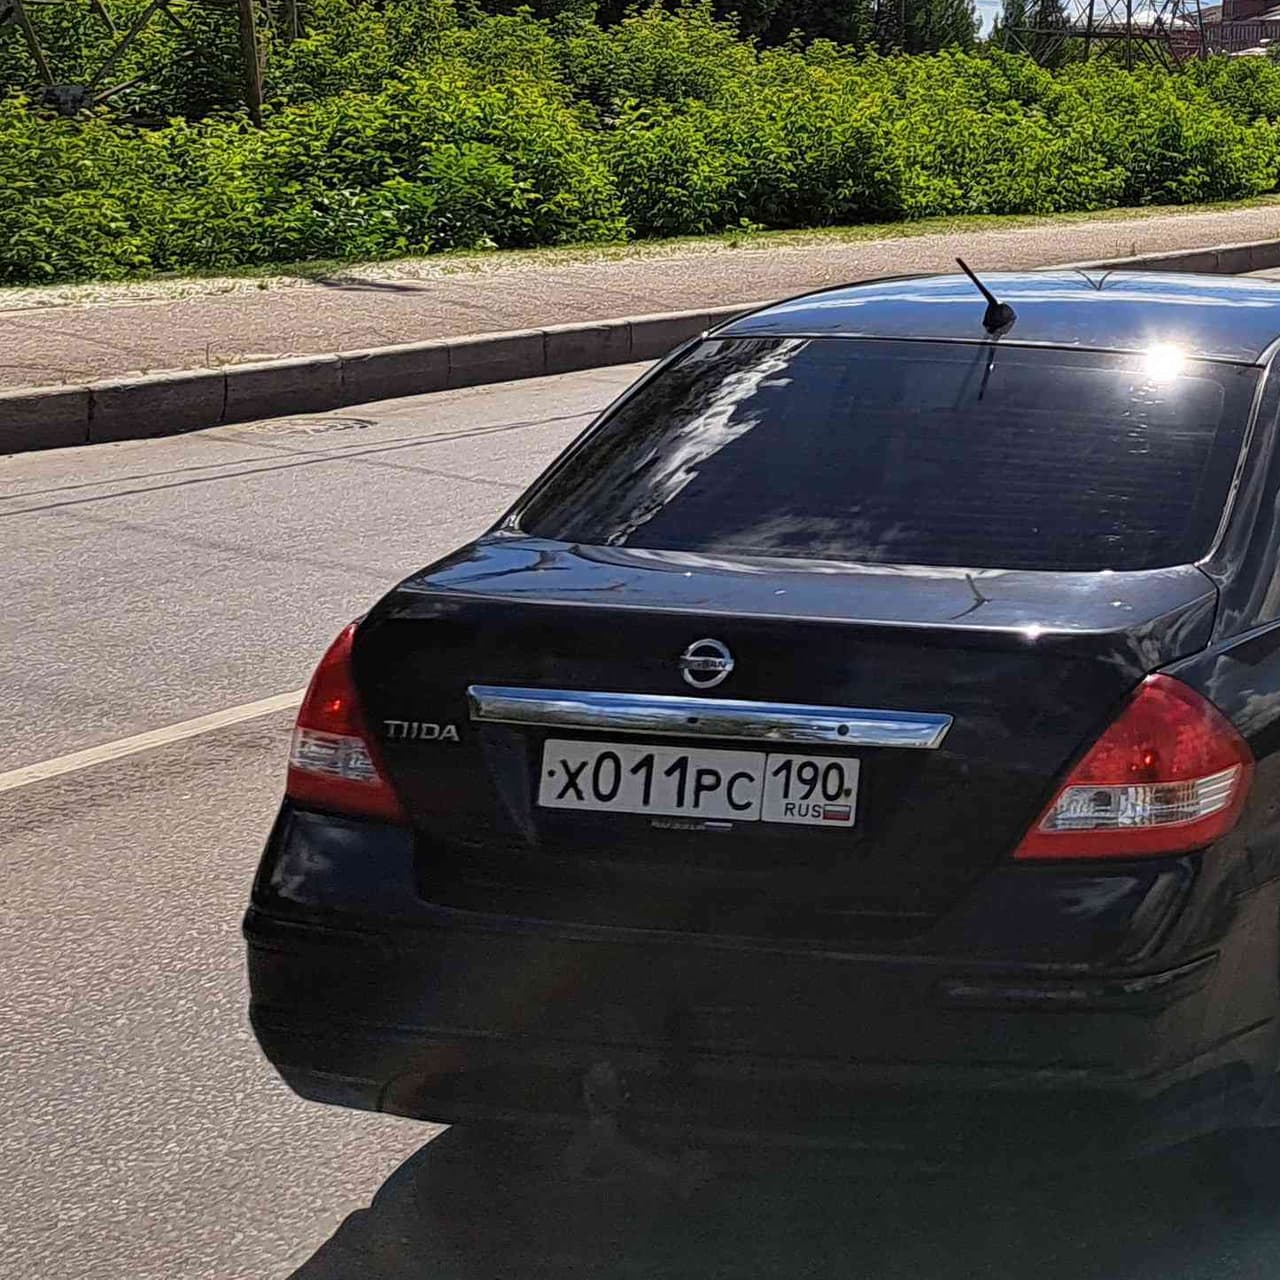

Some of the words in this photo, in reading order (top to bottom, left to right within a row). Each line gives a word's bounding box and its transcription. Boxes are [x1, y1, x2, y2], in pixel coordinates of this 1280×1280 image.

[383, 719, 460, 741] TIIDA
[771, 758, 846, 802] 190
[783, 802, 822, 818] RUS
